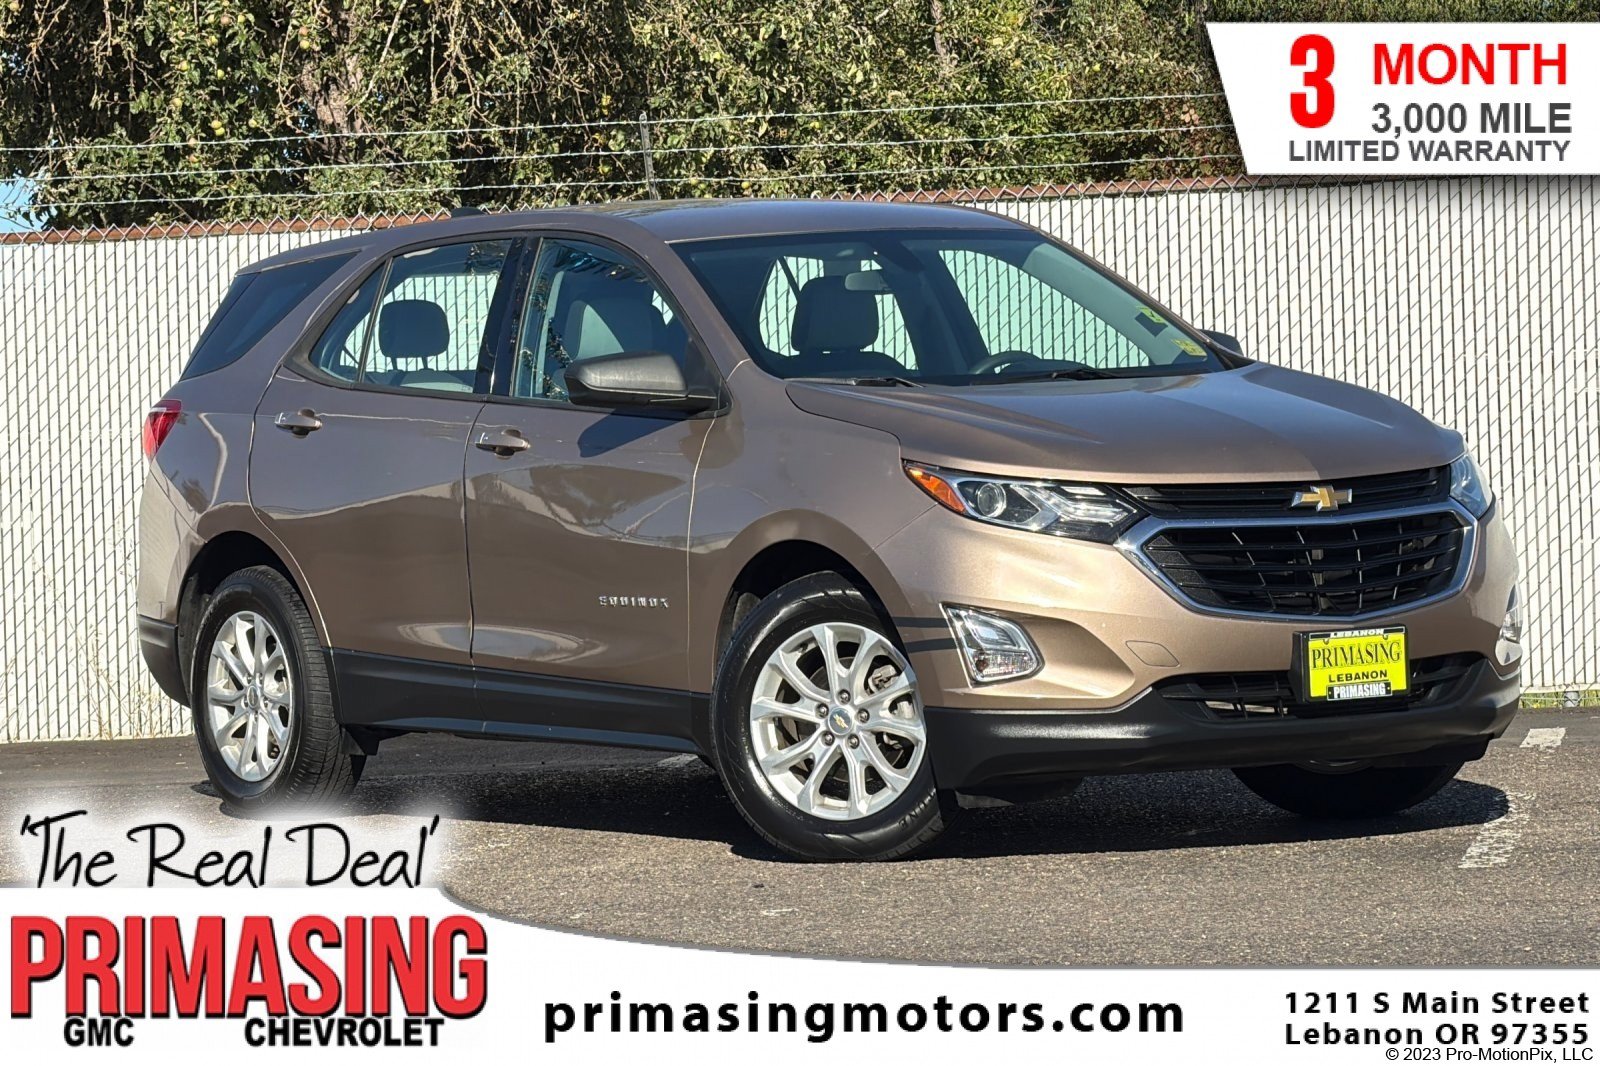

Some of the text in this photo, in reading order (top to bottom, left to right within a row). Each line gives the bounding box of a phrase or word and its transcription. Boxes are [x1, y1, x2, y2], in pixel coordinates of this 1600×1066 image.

[598, 595, 669, 608] EQUINOX
[1329, 628, 1384, 638] LEBANON
[1311, 640, 1401, 669] PRIMASING
[1328, 669, 1388, 683] LEBANON
[1333, 683, 1386, 699] PRIMASING
